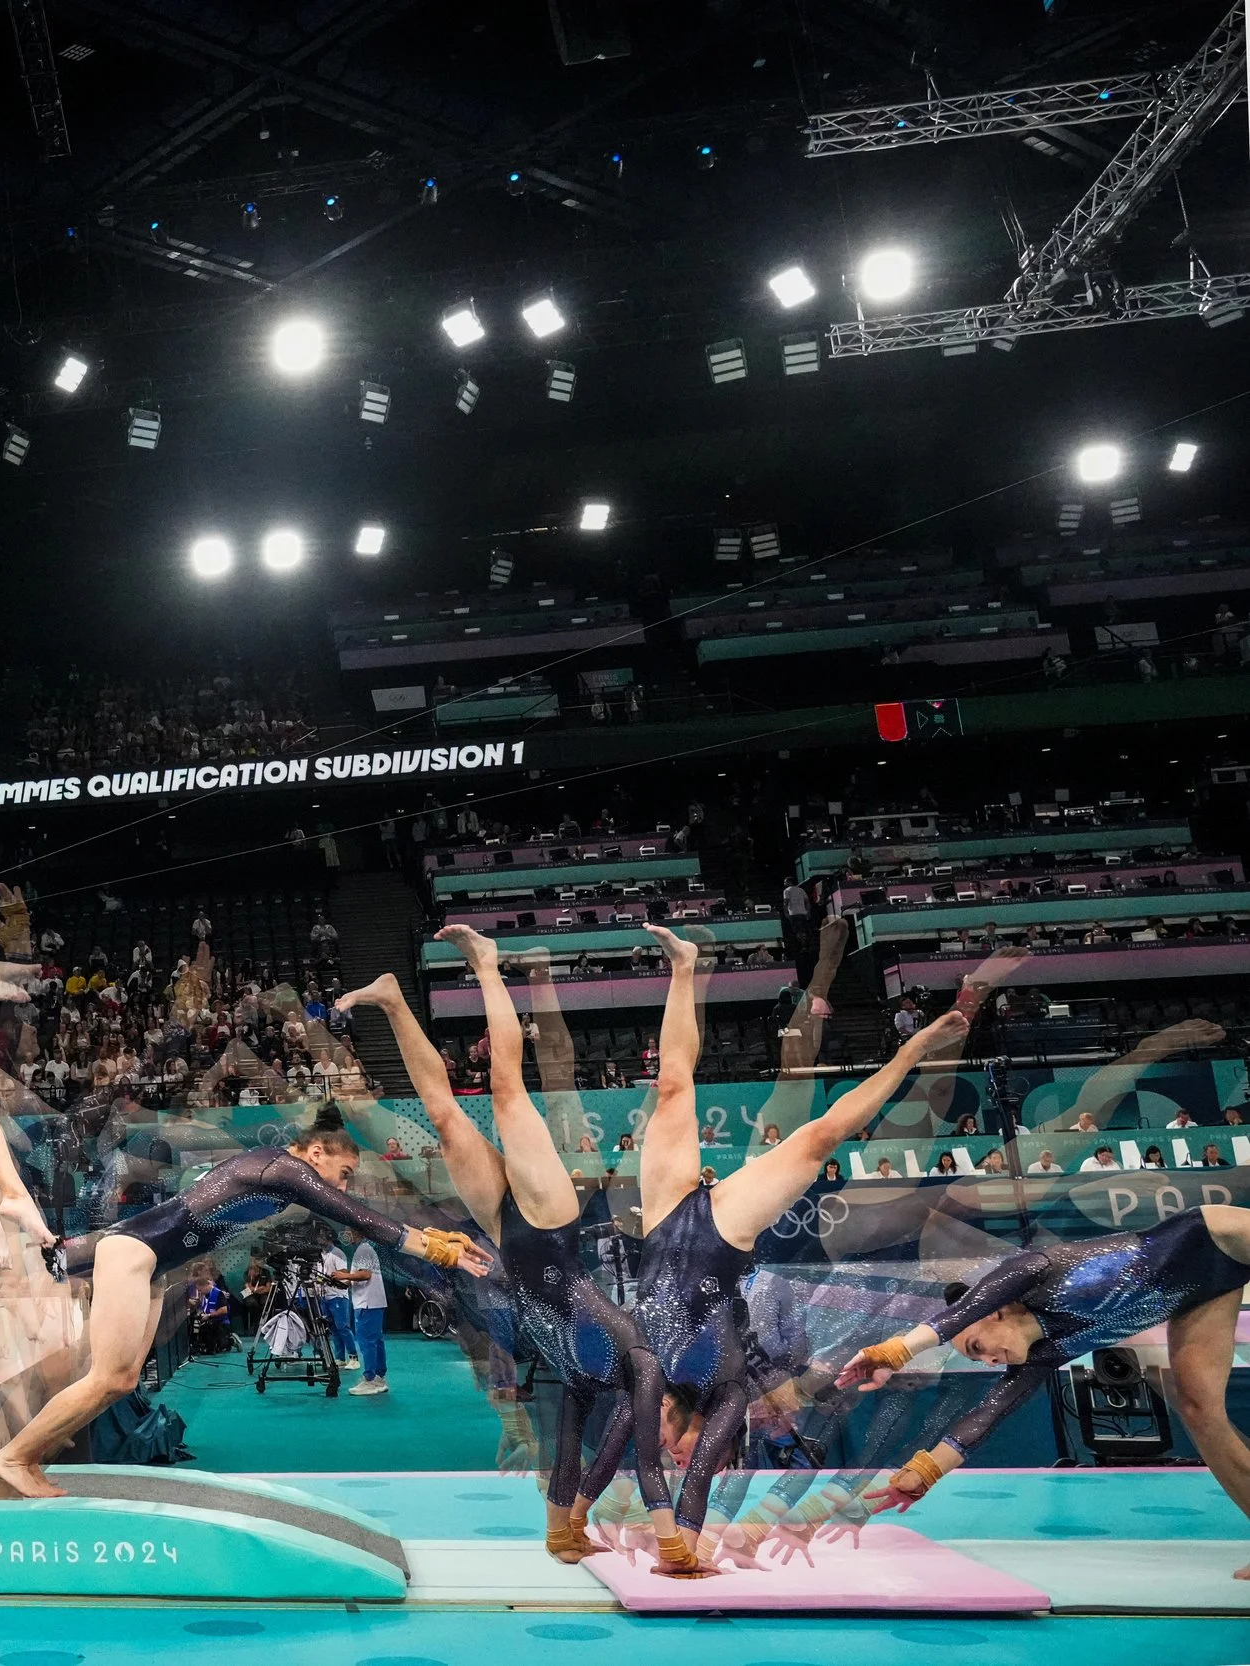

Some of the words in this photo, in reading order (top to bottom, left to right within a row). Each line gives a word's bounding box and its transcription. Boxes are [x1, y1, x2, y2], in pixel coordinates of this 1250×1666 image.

[87, 758, 308, 798] QUALIFICATION
[314, 742, 505, 779] SUBDIVISION
[511, 740, 525, 764] 1
[628, 1104, 765, 1141] 224
[93, 1541, 178, 1564] 2024
